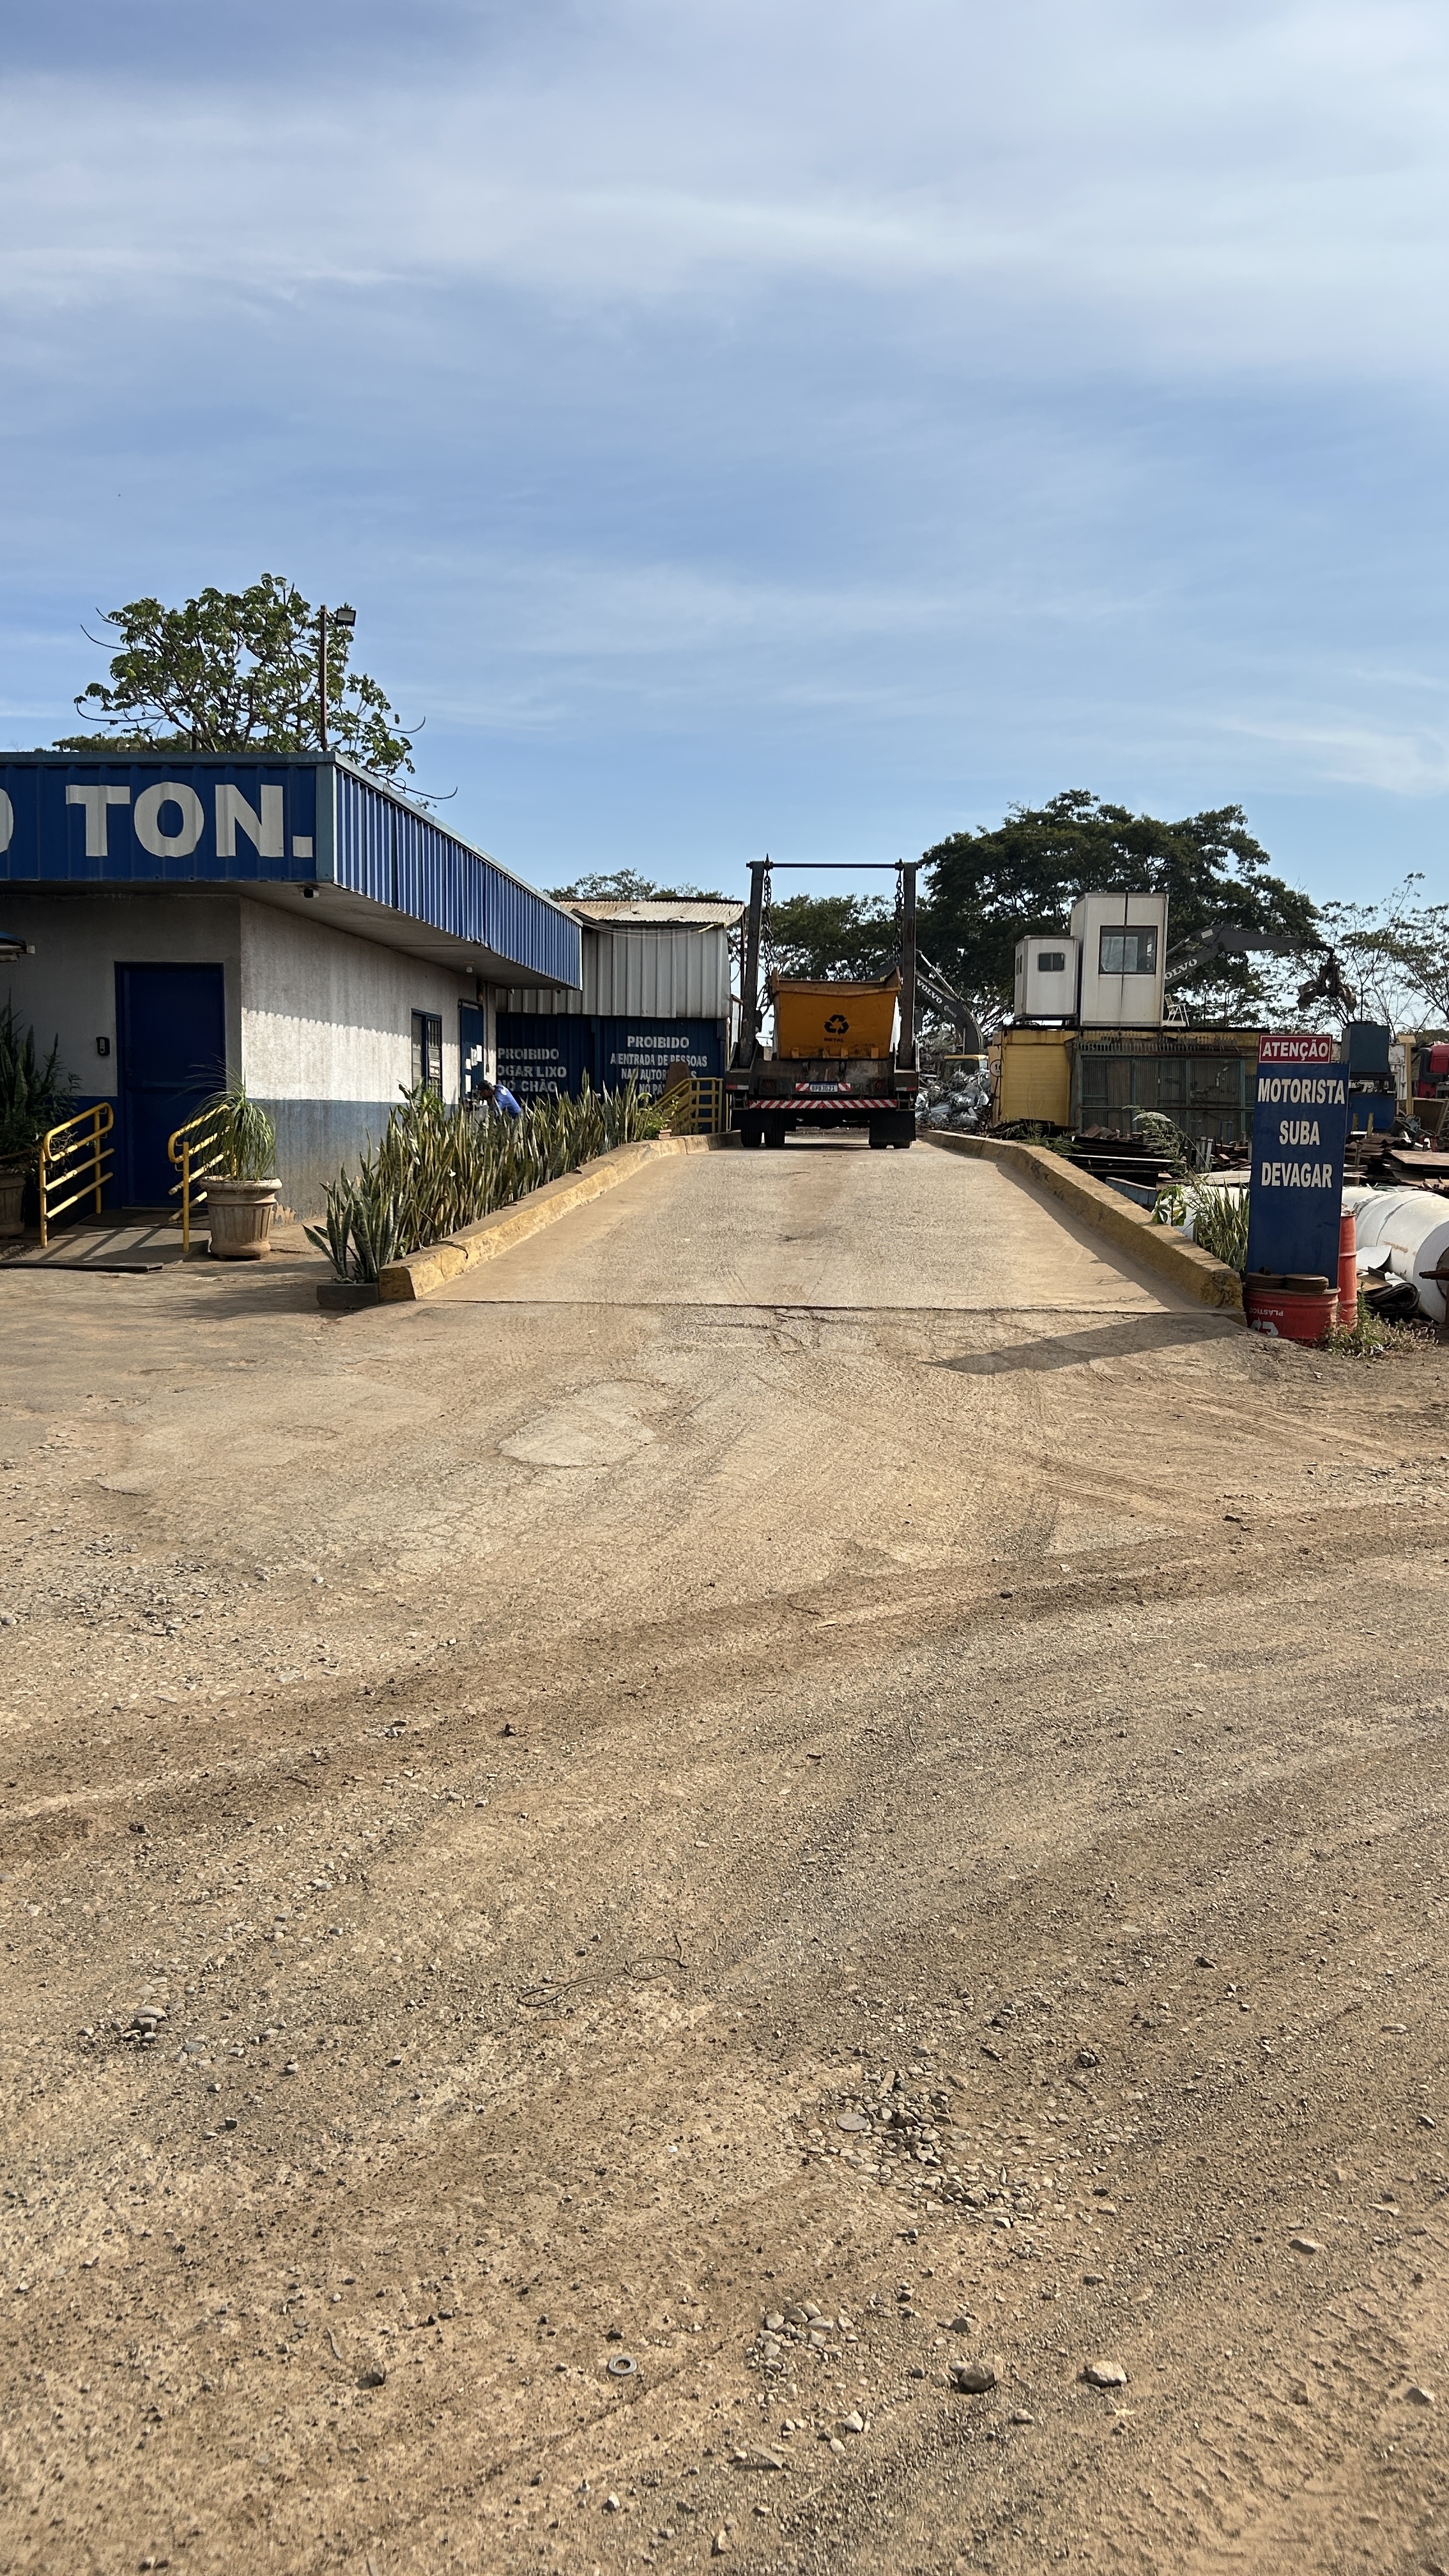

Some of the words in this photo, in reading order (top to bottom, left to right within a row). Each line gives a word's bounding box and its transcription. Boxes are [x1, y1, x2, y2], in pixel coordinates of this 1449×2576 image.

[66, 781, 313, 858] TON.
[1164, 958, 1198, 980] OLVO
[917, 978, 943, 1004] VOLVO
[627, 1035, 689, 1049] PROIBIDO
[1262, 1039, 1329, 1061] ATENÇÃO
[498, 1048, 559, 1060] PROIBIDO
[610, 1053, 616, 1064] A
[618, 1053, 656, 1066] ENTRADA
[657, 1054, 668, 1066] DE
[537, 1066, 567, 1078] LIXO
[521, 1078, 557, 1092] CHÃO
[1257, 1078, 1346, 1105] MOTORISTA
[1279, 1120, 1320, 1146] SUBA
[1261, 1162, 1333, 1188] DEVAGAR
